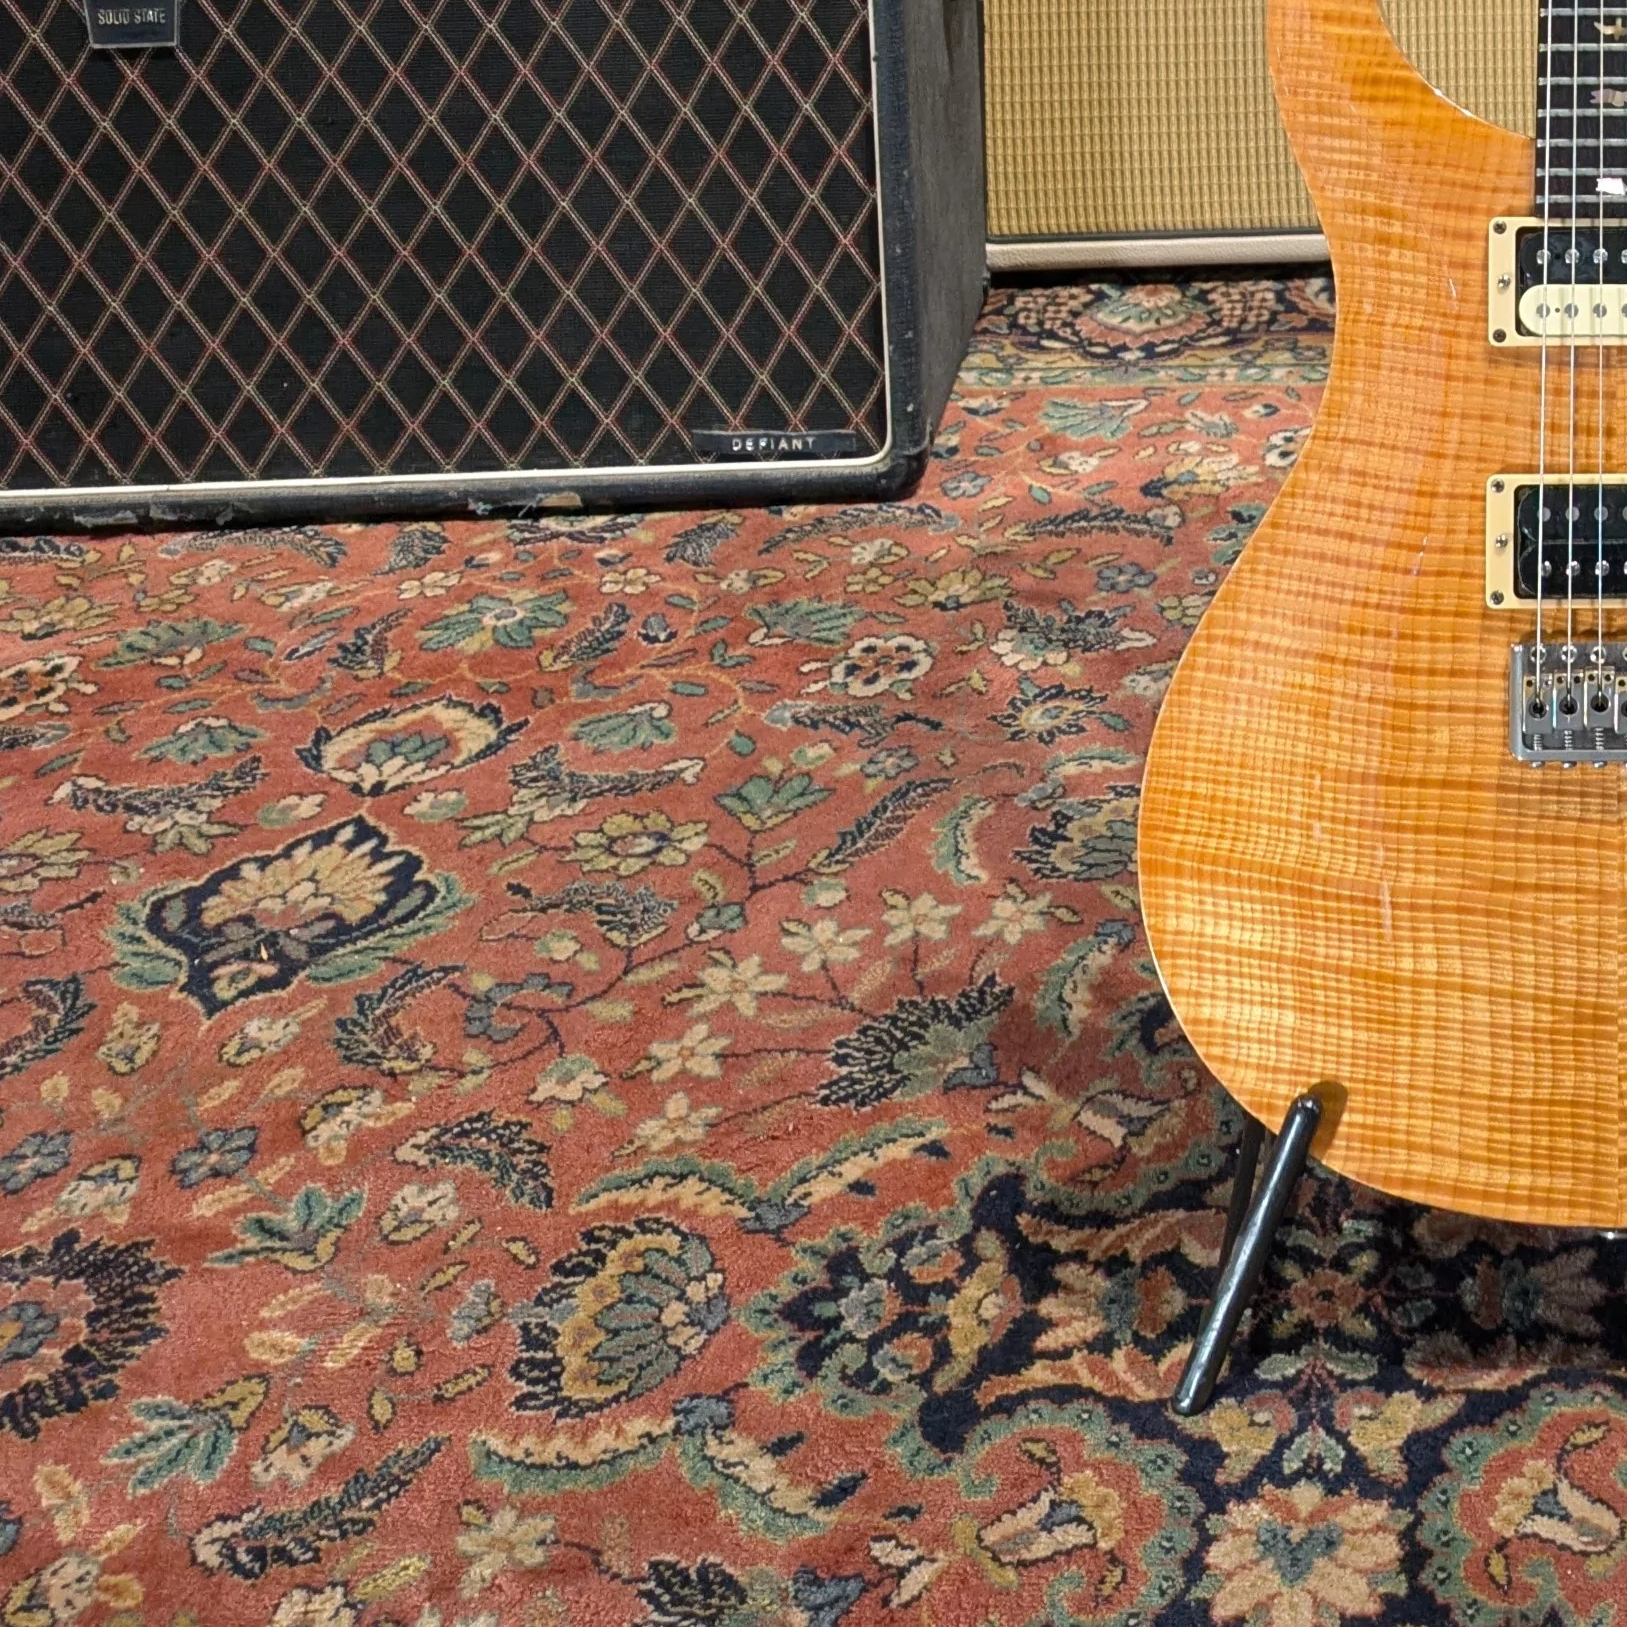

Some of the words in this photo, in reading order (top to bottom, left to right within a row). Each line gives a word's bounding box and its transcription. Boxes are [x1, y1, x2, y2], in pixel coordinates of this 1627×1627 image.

[97, 9, 131, 25] SOLID
[134, 8, 166, 24] STATE
[732, 436, 817, 452] DEFIANT
